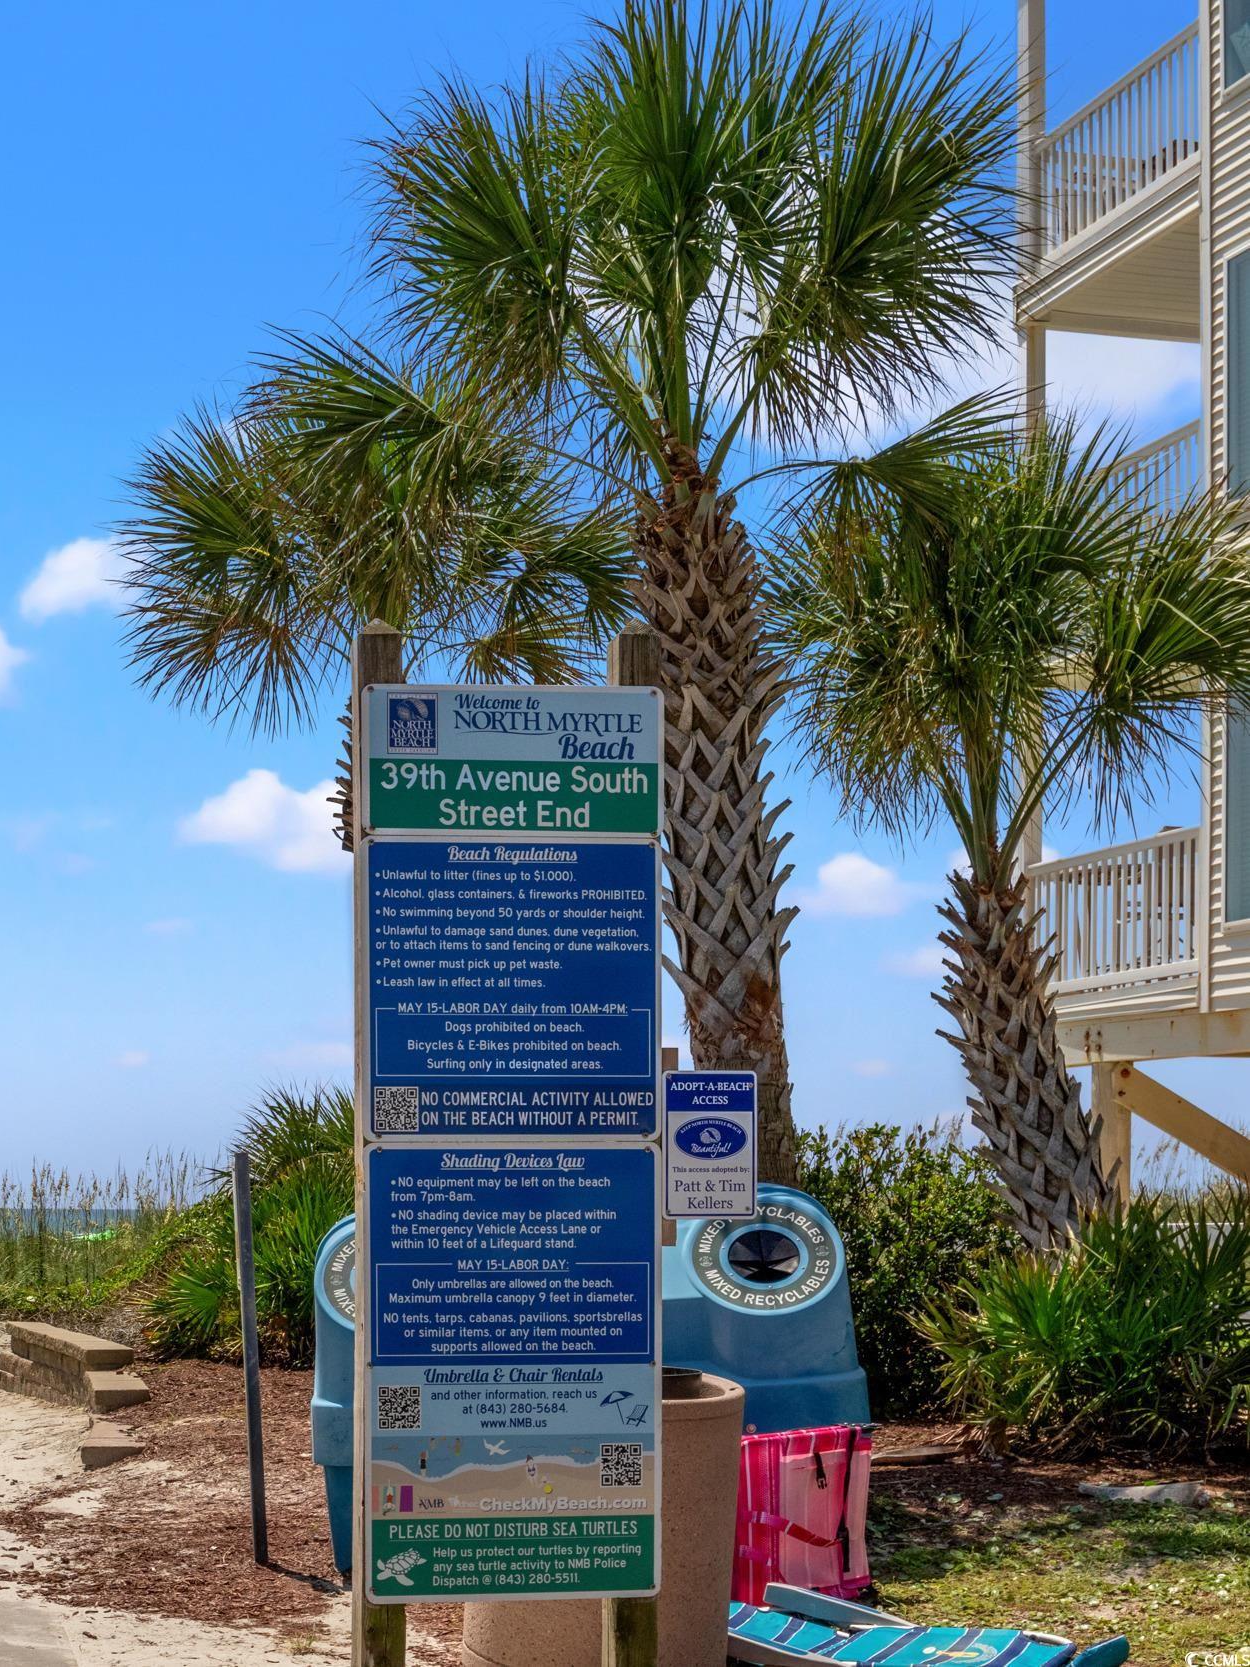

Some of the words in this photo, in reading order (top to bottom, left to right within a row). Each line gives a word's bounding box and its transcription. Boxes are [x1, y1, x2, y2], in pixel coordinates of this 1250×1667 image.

[454, 694, 523, 710] Welcome
[526, 697, 540, 710] to
[393, 720, 431, 730] NORTH
[454, 710, 546, 733] NORTH
[548, 713, 643, 737] MYRTLE
[391, 729, 433, 739] MYRTLE
[394, 738, 430, 747] BEACH
[558, 734, 634, 760] Beach
[381, 763, 445, 790] 39th
[456, 764, 560, 792] Avenue
[571, 766, 648, 793] South
[439, 799, 527, 826] Street
[537, 800, 590, 828] End
[448, 845, 490, 861] Beach
[495, 846, 578, 865] Regulations
[382, 870, 426, 880] Unlawful
[430, 871, 441, 880] to
[444, 871, 468, 881] litter
[472, 871, 501, 881] (fines
[505, 874, 517, 883] up
[521, 872, 531, 881] to
[428, 889, 455, 901] glass
[458, 890, 515, 900] containers,
[518, 889, 526, 899] &
[529, 890, 578, 900] fireworks
[582, 890, 647, 901] PROHIBITED.
[383, 907, 396, 917] No
[400, 908, 452, 919] swimming
[456, 908, 495, 919] beyond
[498, 908, 512, 918] 50
[516, 908, 545, 920] yards
[563, 909, 607, 919] shoulder
[610, 909, 645, 921] height.
[383, 959, 401, 968] Pet
[439, 960, 464, 969] must
[468, 959, 490, 971] pick
[493, 961, 506, 971] up
[510, 960, 526, 971] pet
[530, 960, 562, 969] waste.
[398, 1003, 422, 1013] MAY
[427, 1003, 479, 1013] 15-LABOR
[483, 1003, 507, 1013] DAY
[512, 1004, 537, 1015] daily
[542, 1004, 566, 1014] from
[571, 1004, 628, 1014] 10AM-4PM:
[445, 1022, 472, 1034] Dogs
[475, 1022, 530, 1034] prohibited
[533, 1024, 546, 1032] on
[550, 1022, 584, 1032] beach.
[671, 1082, 749, 1091] ADOPT-A-BEACH
[421, 1092, 437, 1105] NO
[443, 1092, 527, 1106] COMMERCIAL
[532, 1092, 589, 1106] ACTIVITY
[594, 1092, 653, 1106] ALLOWED
[692, 1096, 728, 1104] ACCESS
[421, 1112, 438, 1125] ON
[443, 1112, 467, 1125] THE
[472, 1112, 514, 1125] BEACH
[519, 1112, 573, 1125] WITHOUT
[577, 1112, 586, 1125] A
[590, 1112, 638, 1125] PERMIT.
[691, 1142, 731, 1158] Beautiful!
[441, 1153, 500, 1172] Shading
[504, 1153, 553, 1168] Devices
[556, 1154, 585, 1171] Law
[398, 1177, 413, 1187] NO
[417, 1177, 474, 1189] equipment
[478, 1180, 500, 1189] may
[505, 1177, 517, 1187] be
[522, 1177, 538, 1187] left
[542, 1179, 555, 1187] on
[558, 1177, 575, 1187] the
[578, 1177, 610, 1186] beach
[674, 1180, 701, 1192] Patt
[705, 1180, 715, 1192] &
[719, 1180, 745, 1192] Tim
[391, 1192, 416, 1201] from
[421, 1192, 476, 1204] 7pm-8am.
[687, 1197, 733, 1208] Kellers
[699, 1220, 726, 1253] MIXED
[727, 1206, 824, 1244] YCLABLES
[458, 1260, 482, 1270] MAY
[487, 1260, 538, 1270] 15-LABOR
[543, 1260, 569, 1270] DAY:
[705, 1269, 741, 1300] MIXED
[744, 1260, 830, 1306] RECYCLABLES
[334, 1289, 355, 1317] MIXE
[424, 1368, 489, 1383] Umbrella
[493, 1369, 505, 1382] &
[509, 1368, 548, 1382] Chair
[552, 1367, 603, 1382] Rentals
[462, 1405, 472, 1414] at
[476, 1404, 506, 1415] (843)
[510, 1403, 568, 1414] 280-5684.
[481, 1418, 547, 1428] www.NMB.us
[480, 1497, 647, 1514] CheckMyBeach.com
[389, 1525, 439, 1539] PLEASE
[445, 1524, 462, 1538] DO
[466, 1524, 490, 1537] NOT
[495, 1523, 548, 1537] DISTURB
[553, 1522, 577, 1536] SEA
[582, 1521, 637, 1535] TURTLES
[433, 1576, 479, 1588] Dispatch
[482, 1575, 492, 1585] @
[495, 1574, 525, 1585] (843)
[529, 1573, 580, 1584] 280-5511.
